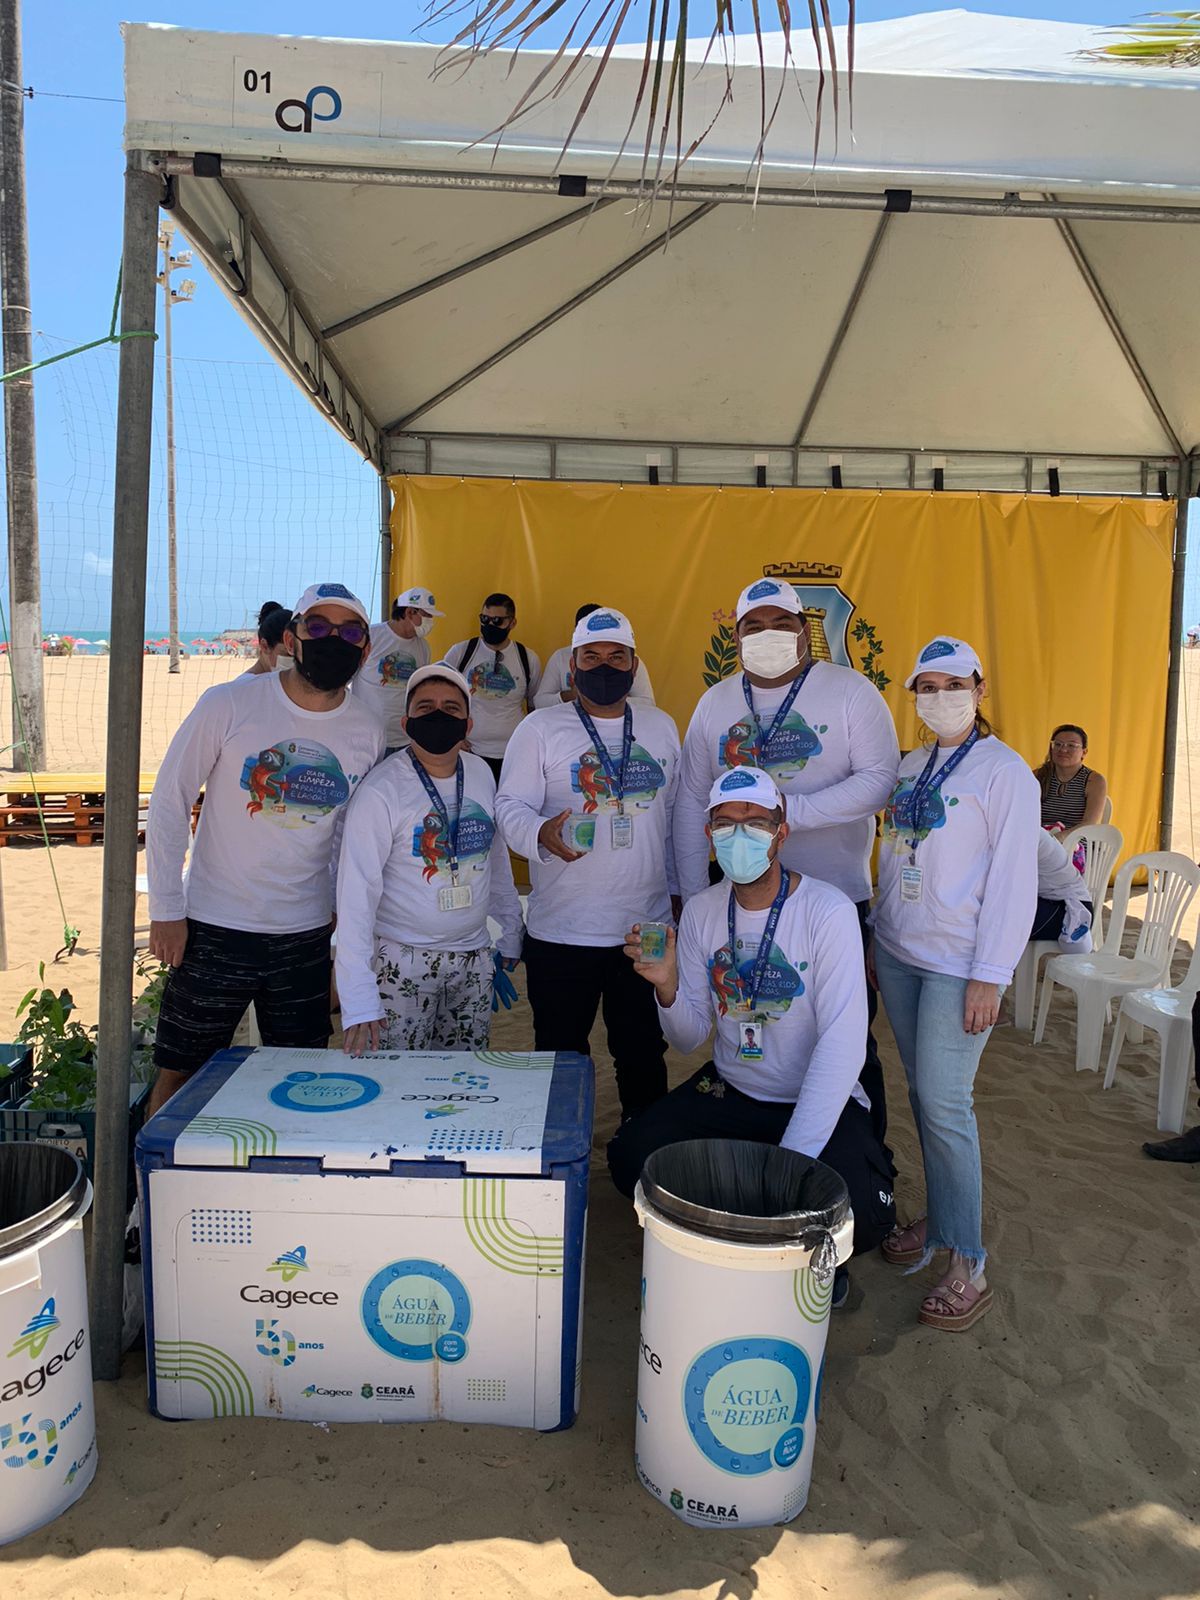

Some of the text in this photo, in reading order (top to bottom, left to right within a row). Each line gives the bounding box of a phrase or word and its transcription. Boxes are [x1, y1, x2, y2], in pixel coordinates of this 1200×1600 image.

[243, 69, 272, 94] 01
[298, 775, 336, 788] LIMPEZA
[401, 1093, 500, 1104] Cagece
[240, 1285, 339, 1309] Cagece
[392, 1294, 440, 1311] ÁGUA
[394, 1312, 447, 1326] BEBER
[298, 1342, 325, 1350] anos
[0, 1328, 85, 1404] agece
[316, 1387, 353, 1398] Cagece
[376, 1385, 415, 1395] CEARÁ
[721, 1384, 782, 1406] ÁGUA
[59, 1402, 83, 1430] anos
[724, 1405, 789, 1426] BEBER
[687, 1498, 739, 1518] CEARÁ
